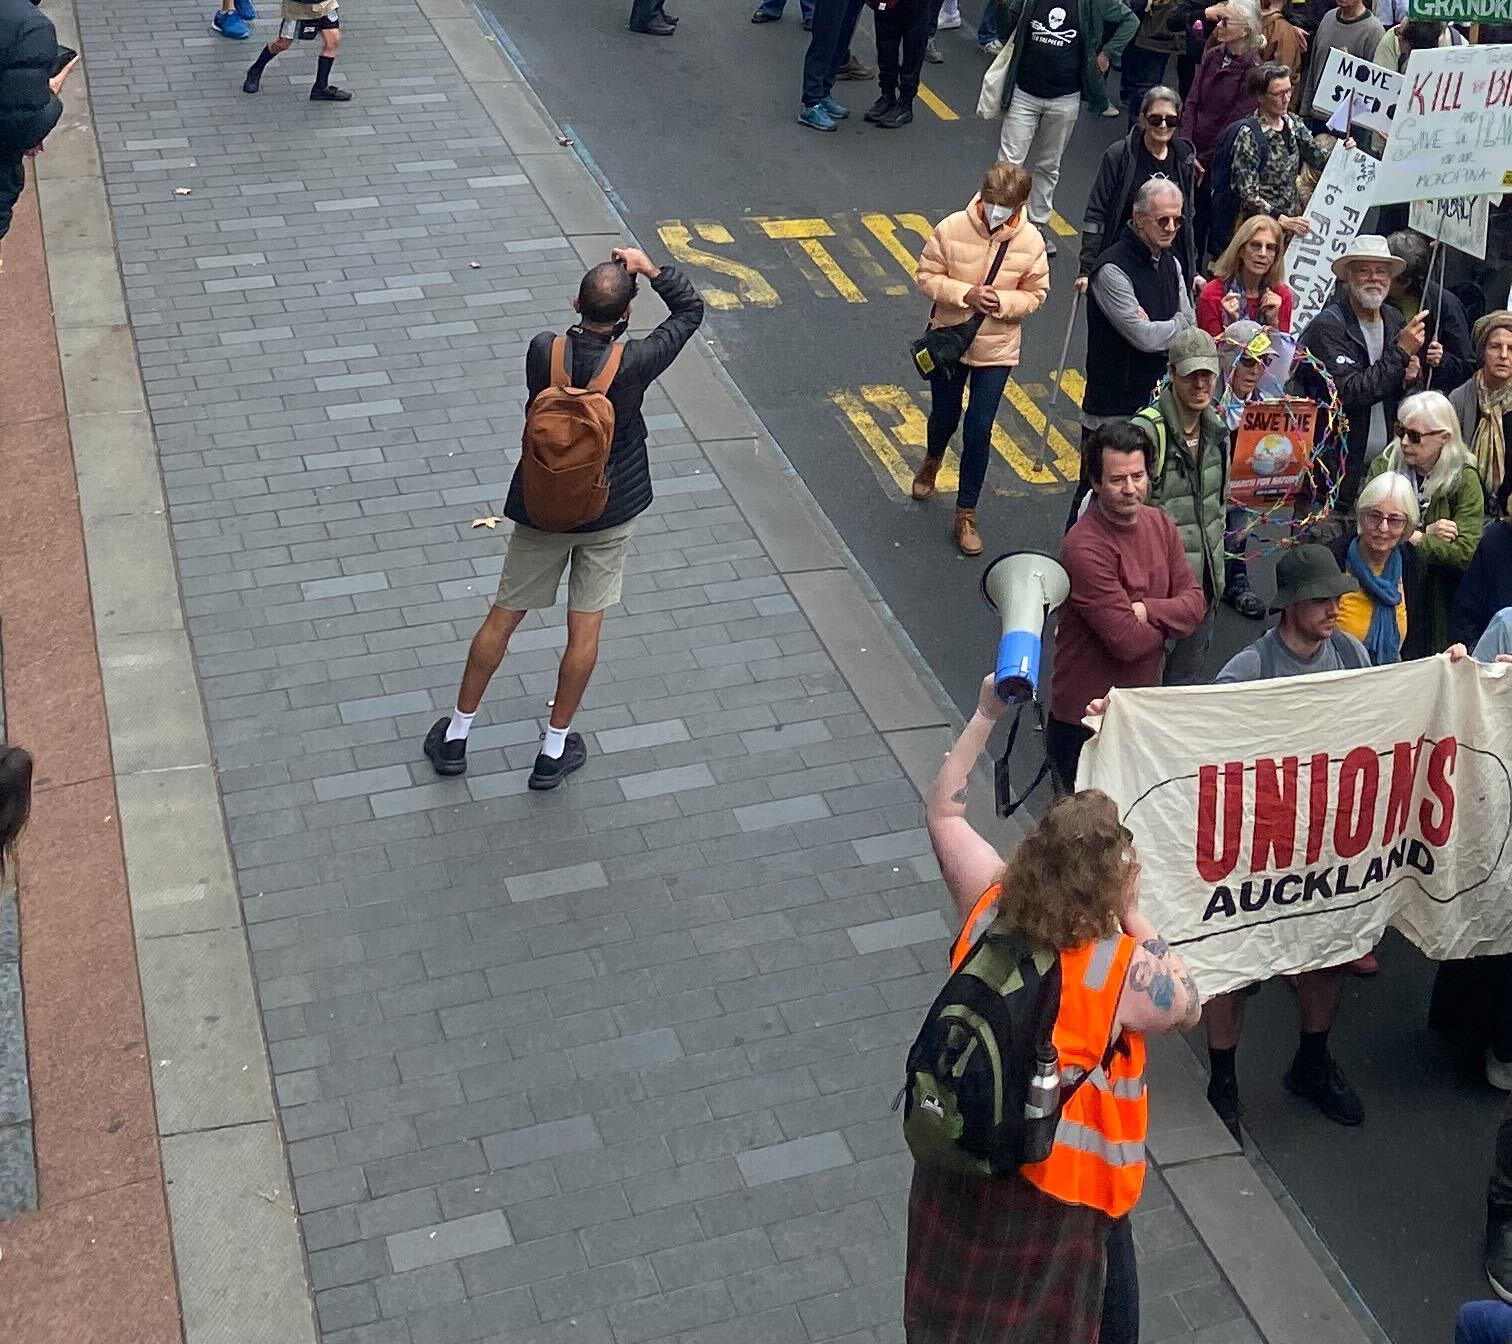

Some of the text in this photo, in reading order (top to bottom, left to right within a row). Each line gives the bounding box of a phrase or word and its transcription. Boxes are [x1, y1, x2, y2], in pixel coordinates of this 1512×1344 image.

[1337, 57, 1392, 91] MOVE
[1408, 70, 1464, 115] KILL
[1391, 117, 1442, 162] SAVE
[1323, 183, 1343, 206] to
[1243, 412, 1281, 432] SAVE
[1194, 735, 1458, 884] UNIONS
[1201, 839, 1436, 922] AUCKLAND
